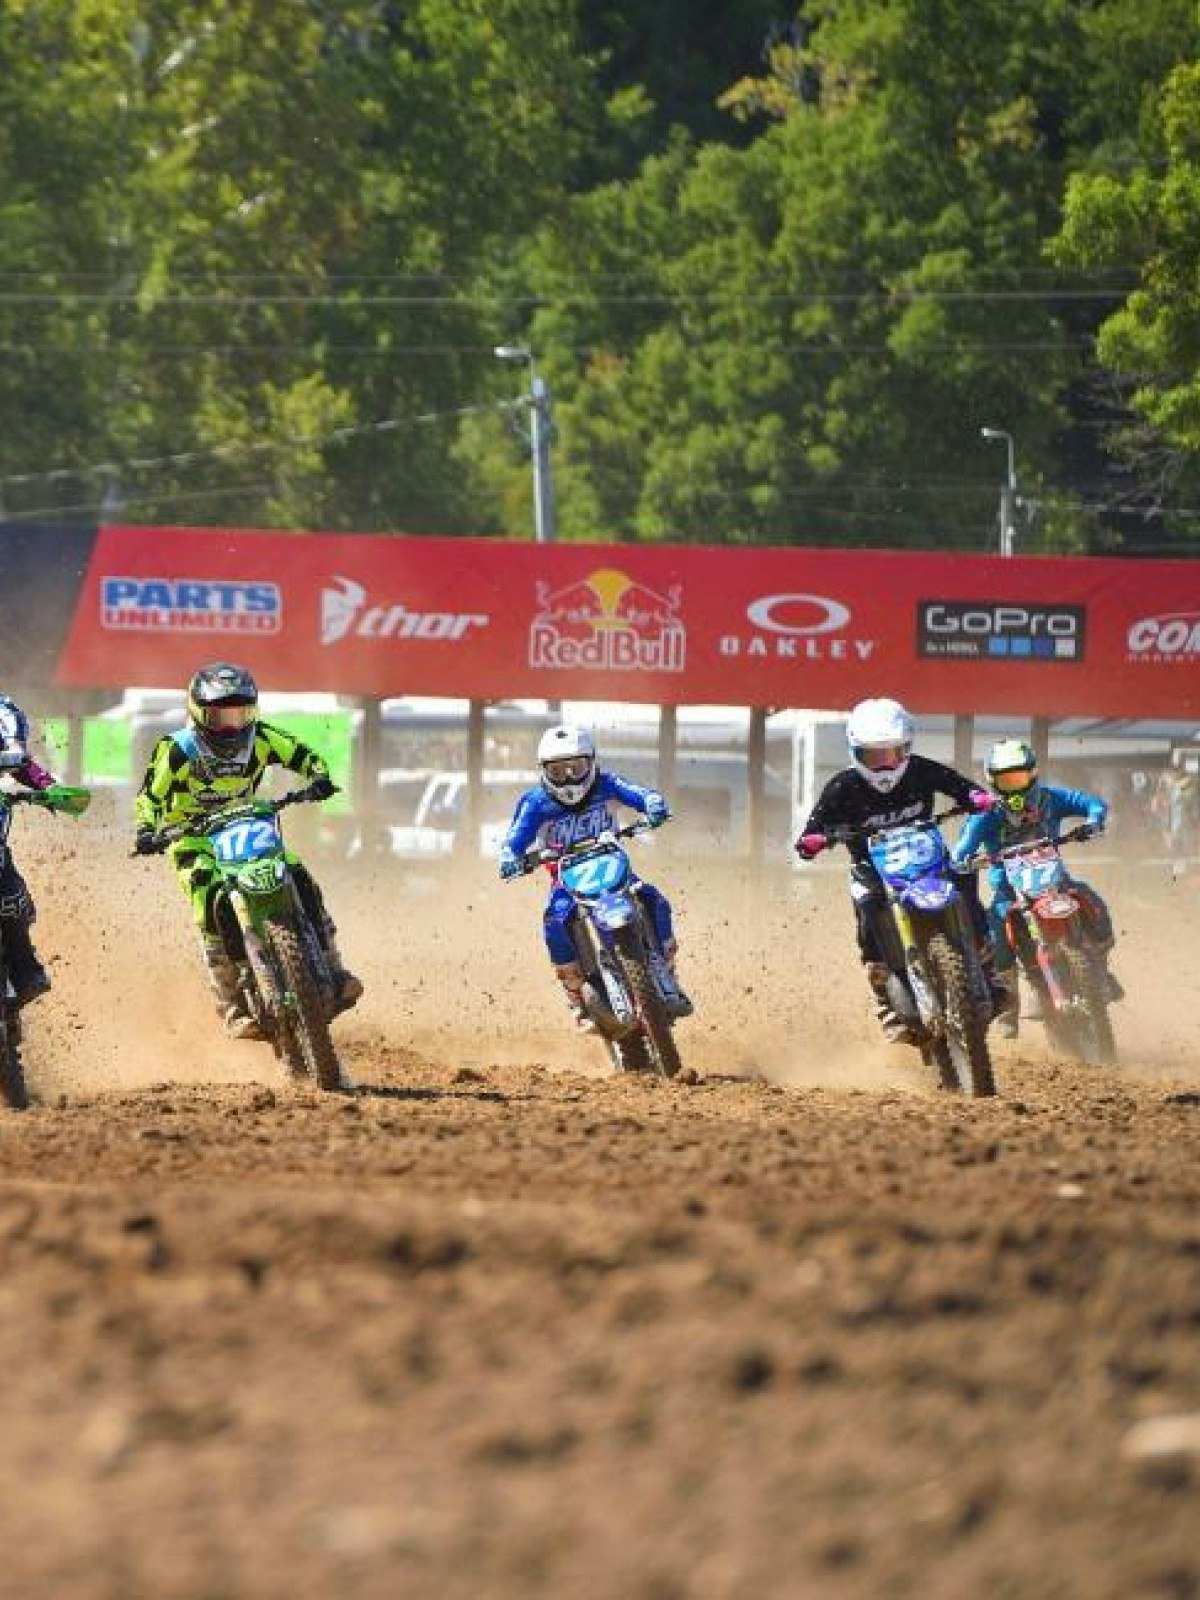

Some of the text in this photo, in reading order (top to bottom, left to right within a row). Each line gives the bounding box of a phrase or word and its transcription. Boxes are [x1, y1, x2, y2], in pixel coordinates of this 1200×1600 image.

[105, 579, 279, 612] PARTS
[105, 609, 278, 631] UNLIMITED
[357, 604, 490, 639] thor
[926, 605, 1077, 635] GoPro
[531, 623, 686, 672] Red Bull
[719, 635, 875, 661] OAKLEY
[216, 819, 276, 860] 172
